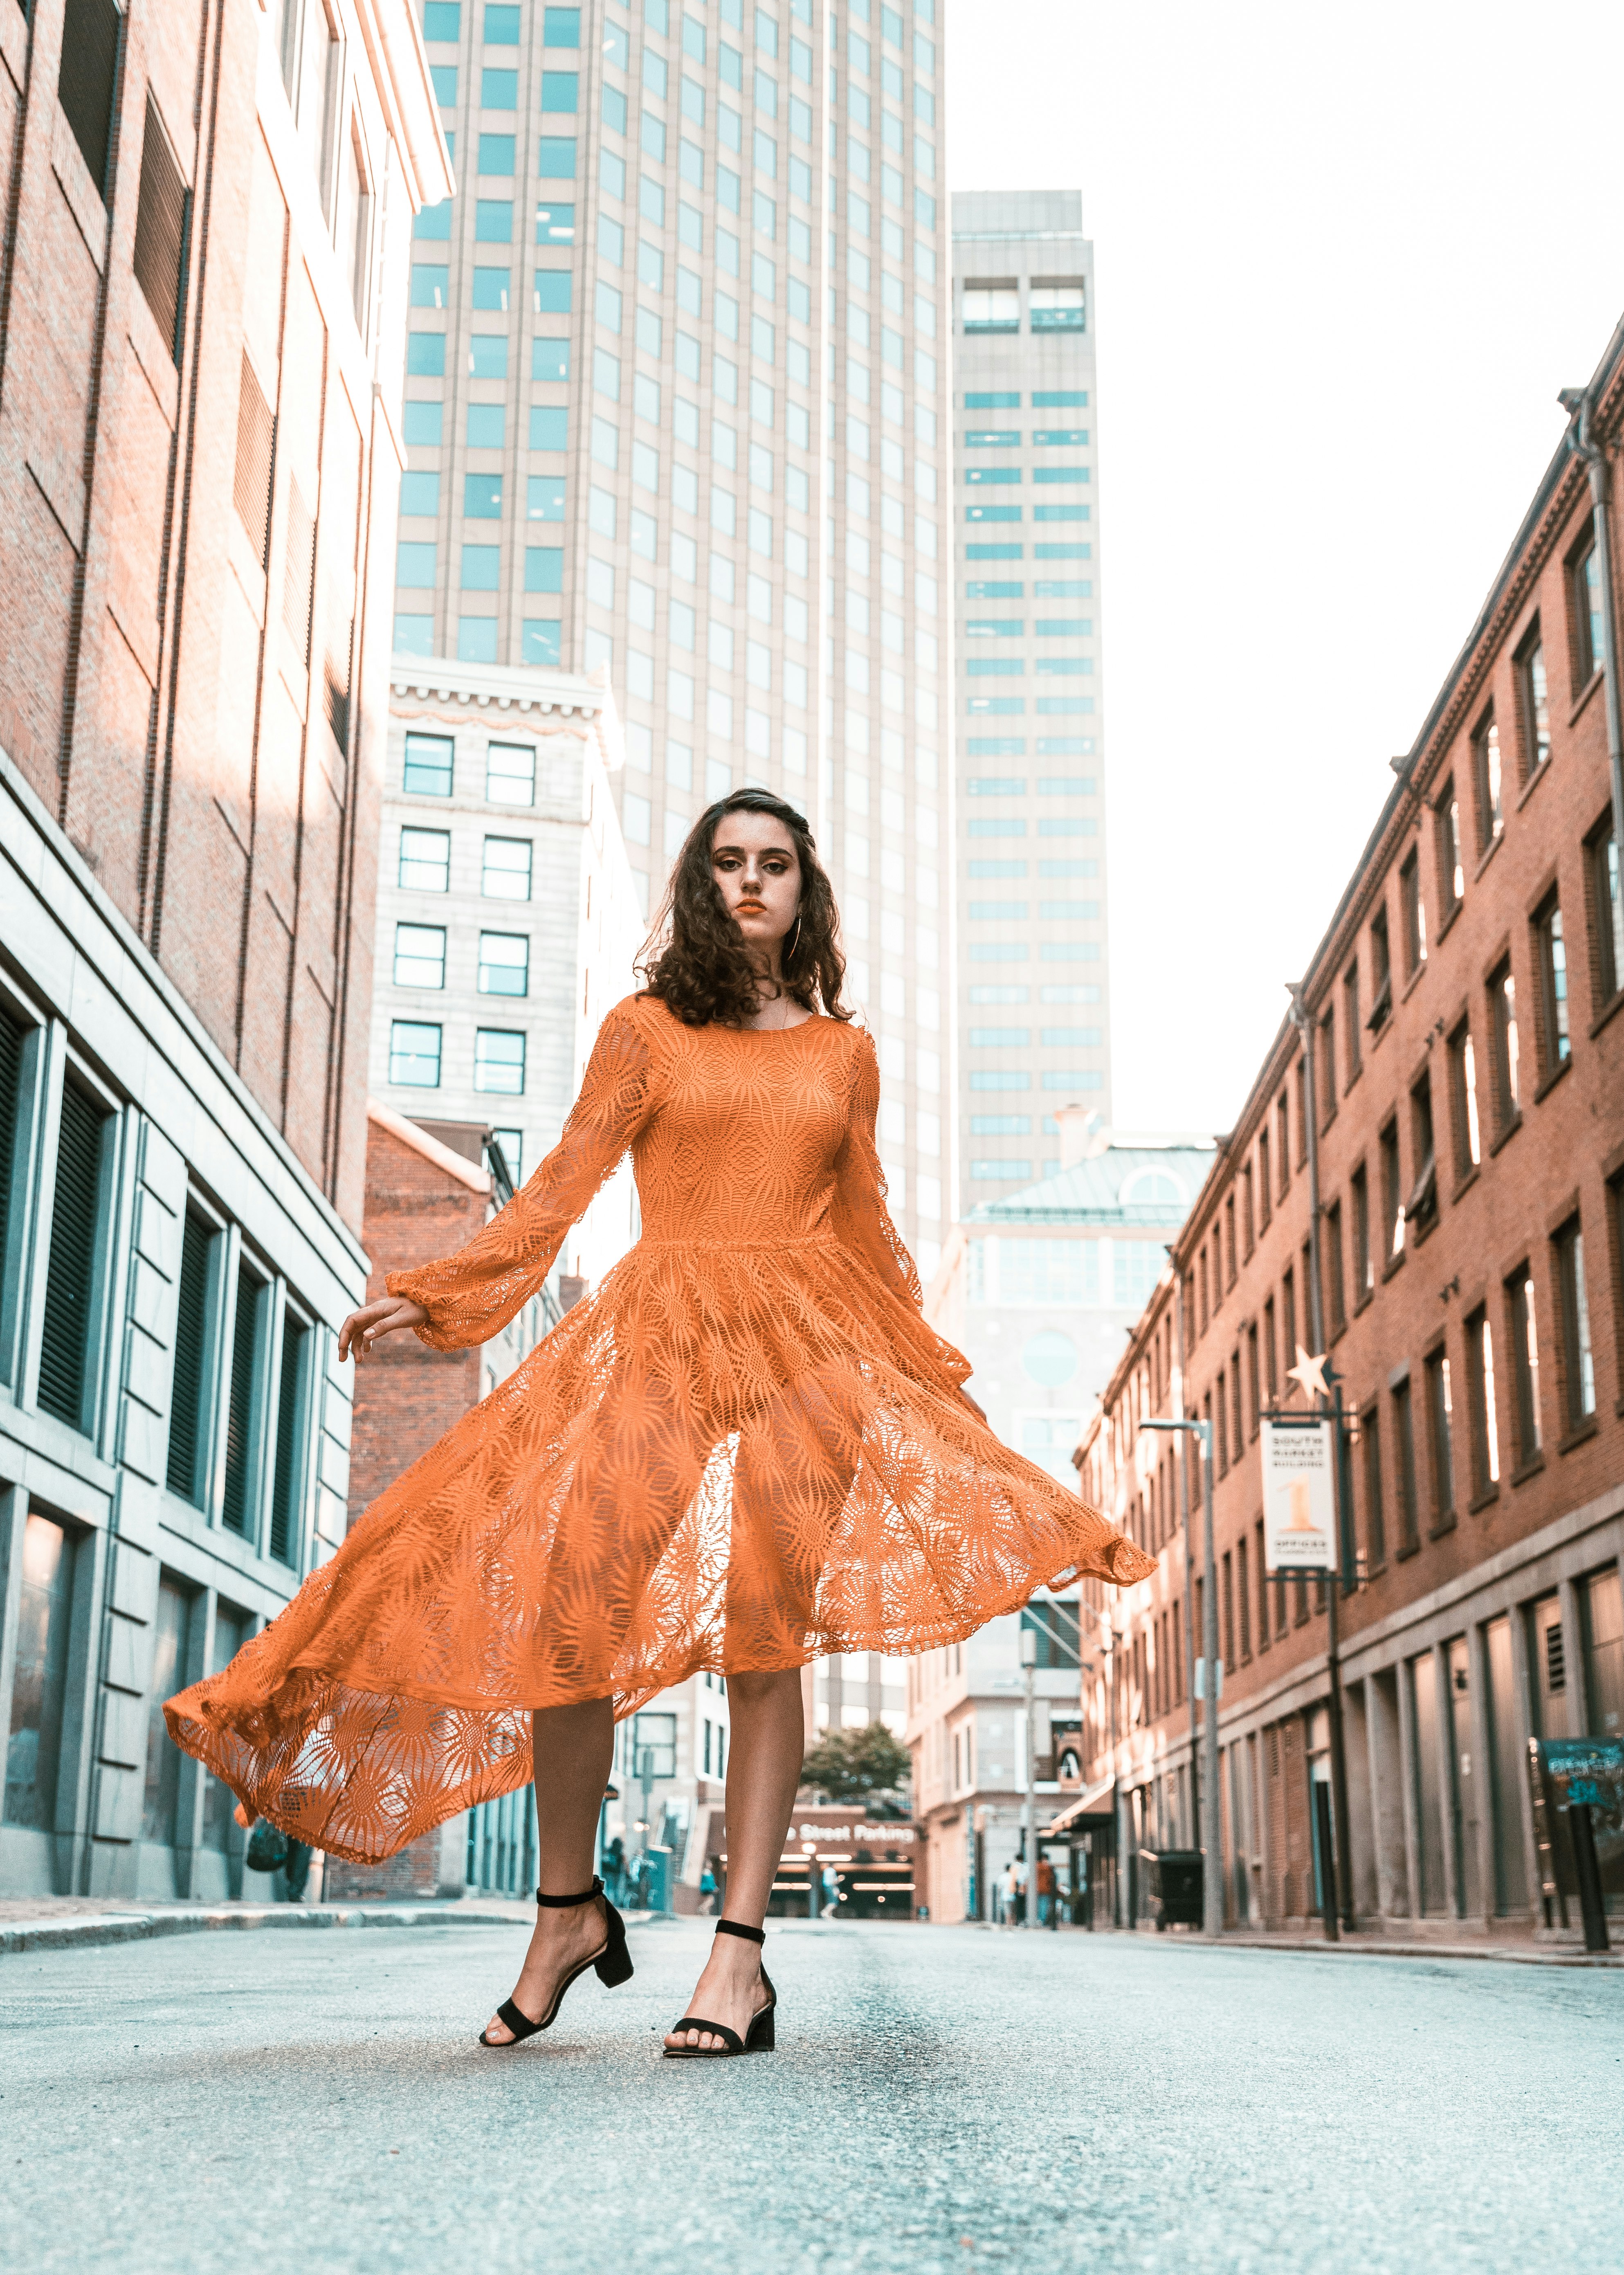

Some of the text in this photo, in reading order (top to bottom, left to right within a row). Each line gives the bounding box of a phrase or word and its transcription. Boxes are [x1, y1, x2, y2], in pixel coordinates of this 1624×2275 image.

[1273, 1436, 1323, 1446] SOUTH
[1276, 1472, 1325, 1533] 1
[800, 1823, 850, 1841] Street
[854, 1824, 914, 1843] Parking
